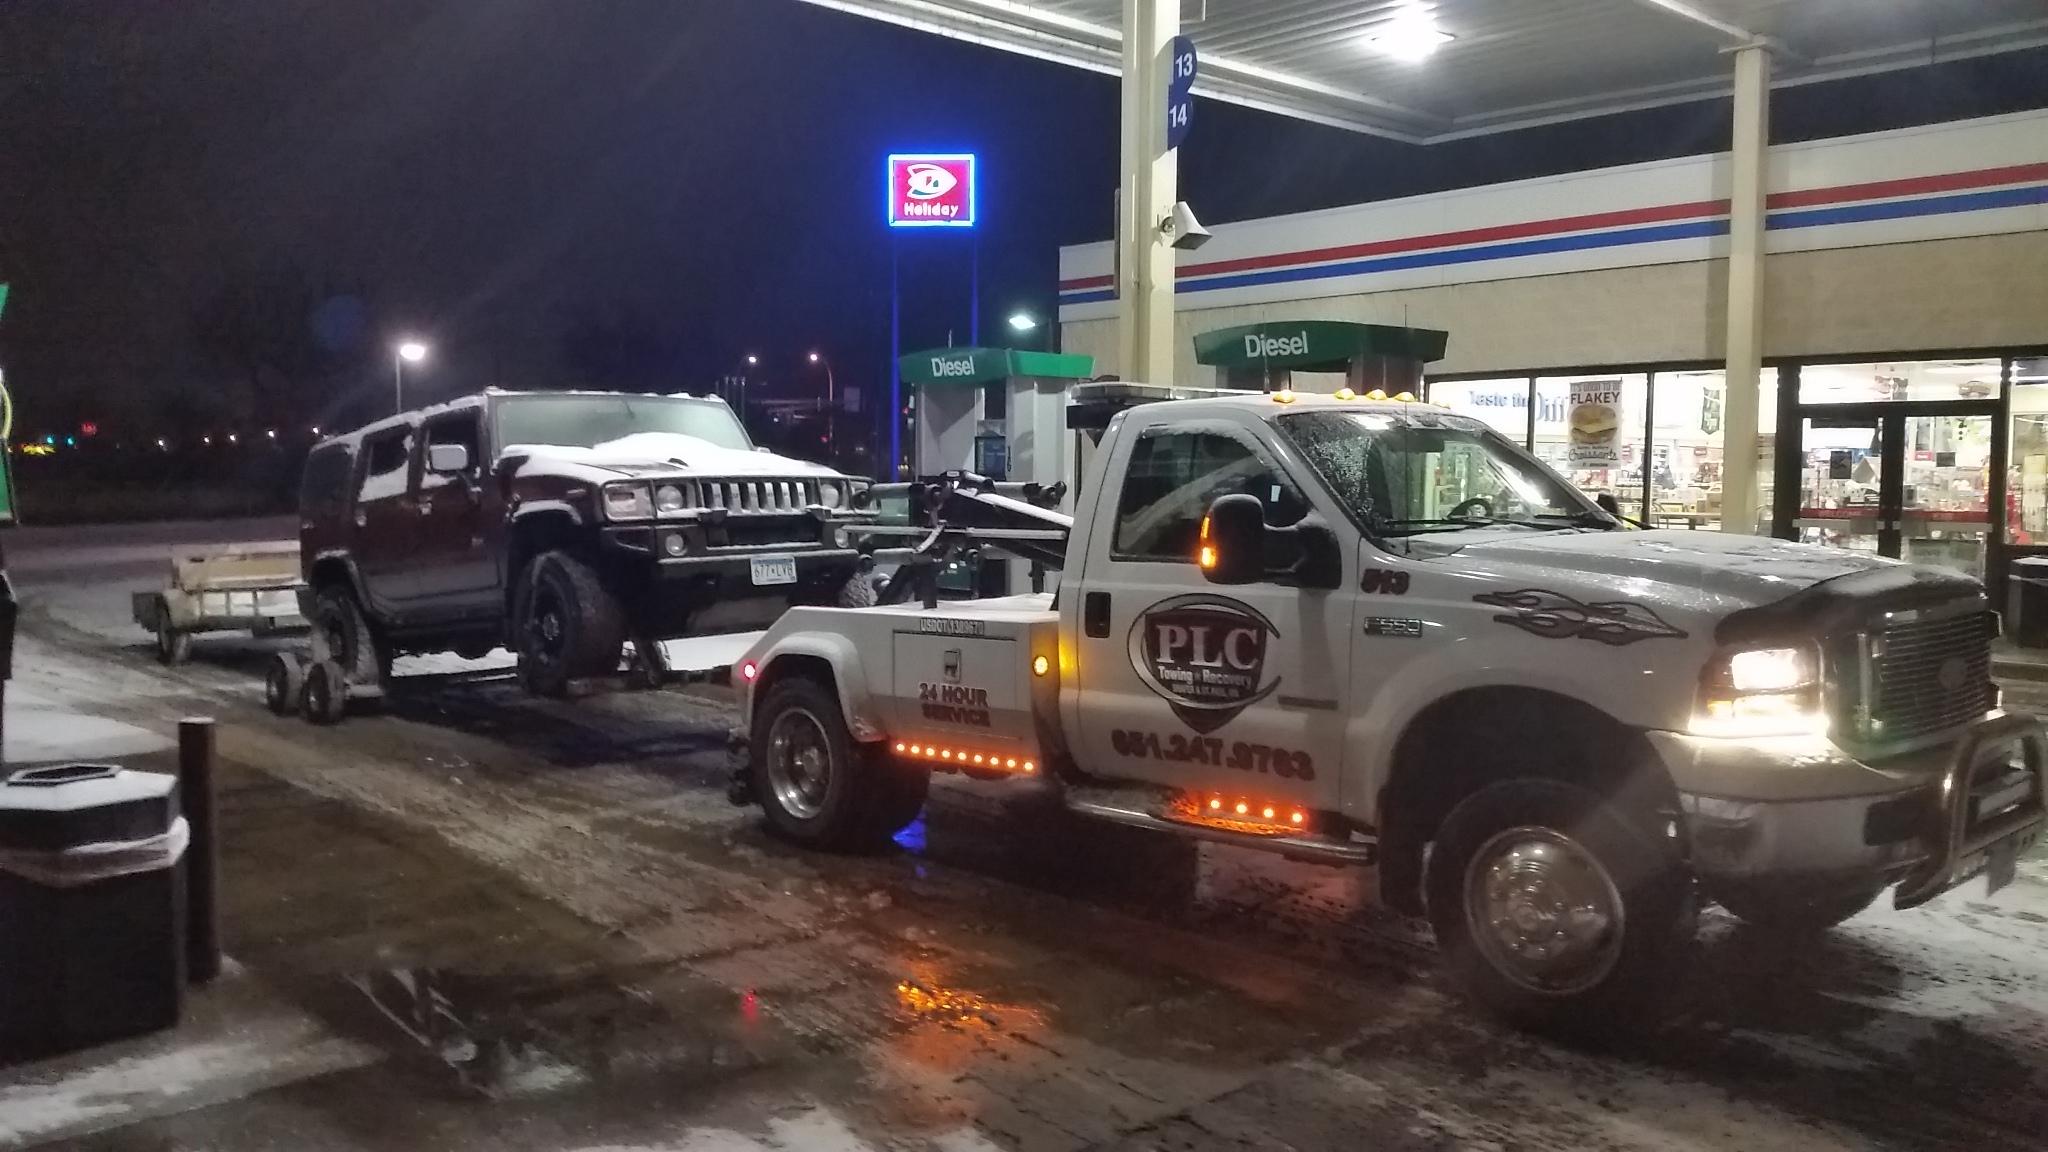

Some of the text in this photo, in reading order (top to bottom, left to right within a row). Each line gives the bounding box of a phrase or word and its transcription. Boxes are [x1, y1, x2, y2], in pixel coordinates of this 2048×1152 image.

[1175, 53, 1193, 77] 13
[1169, 103, 1187, 128] 14
[904, 202, 959, 217] Holiday
[1244, 331, 1308, 358] Diesel
[931, 356, 975, 378] Diesel
[1571, 391, 1620, 404] FLAKEY
[920, 617, 947, 633] USDOT
[1156, 624, 1259, 670] PLC
[1158, 665, 1252, 689] Towing Recovery
[919, 682, 989, 708] 24 HOUR
[920, 703, 991, 727] SERVICE
